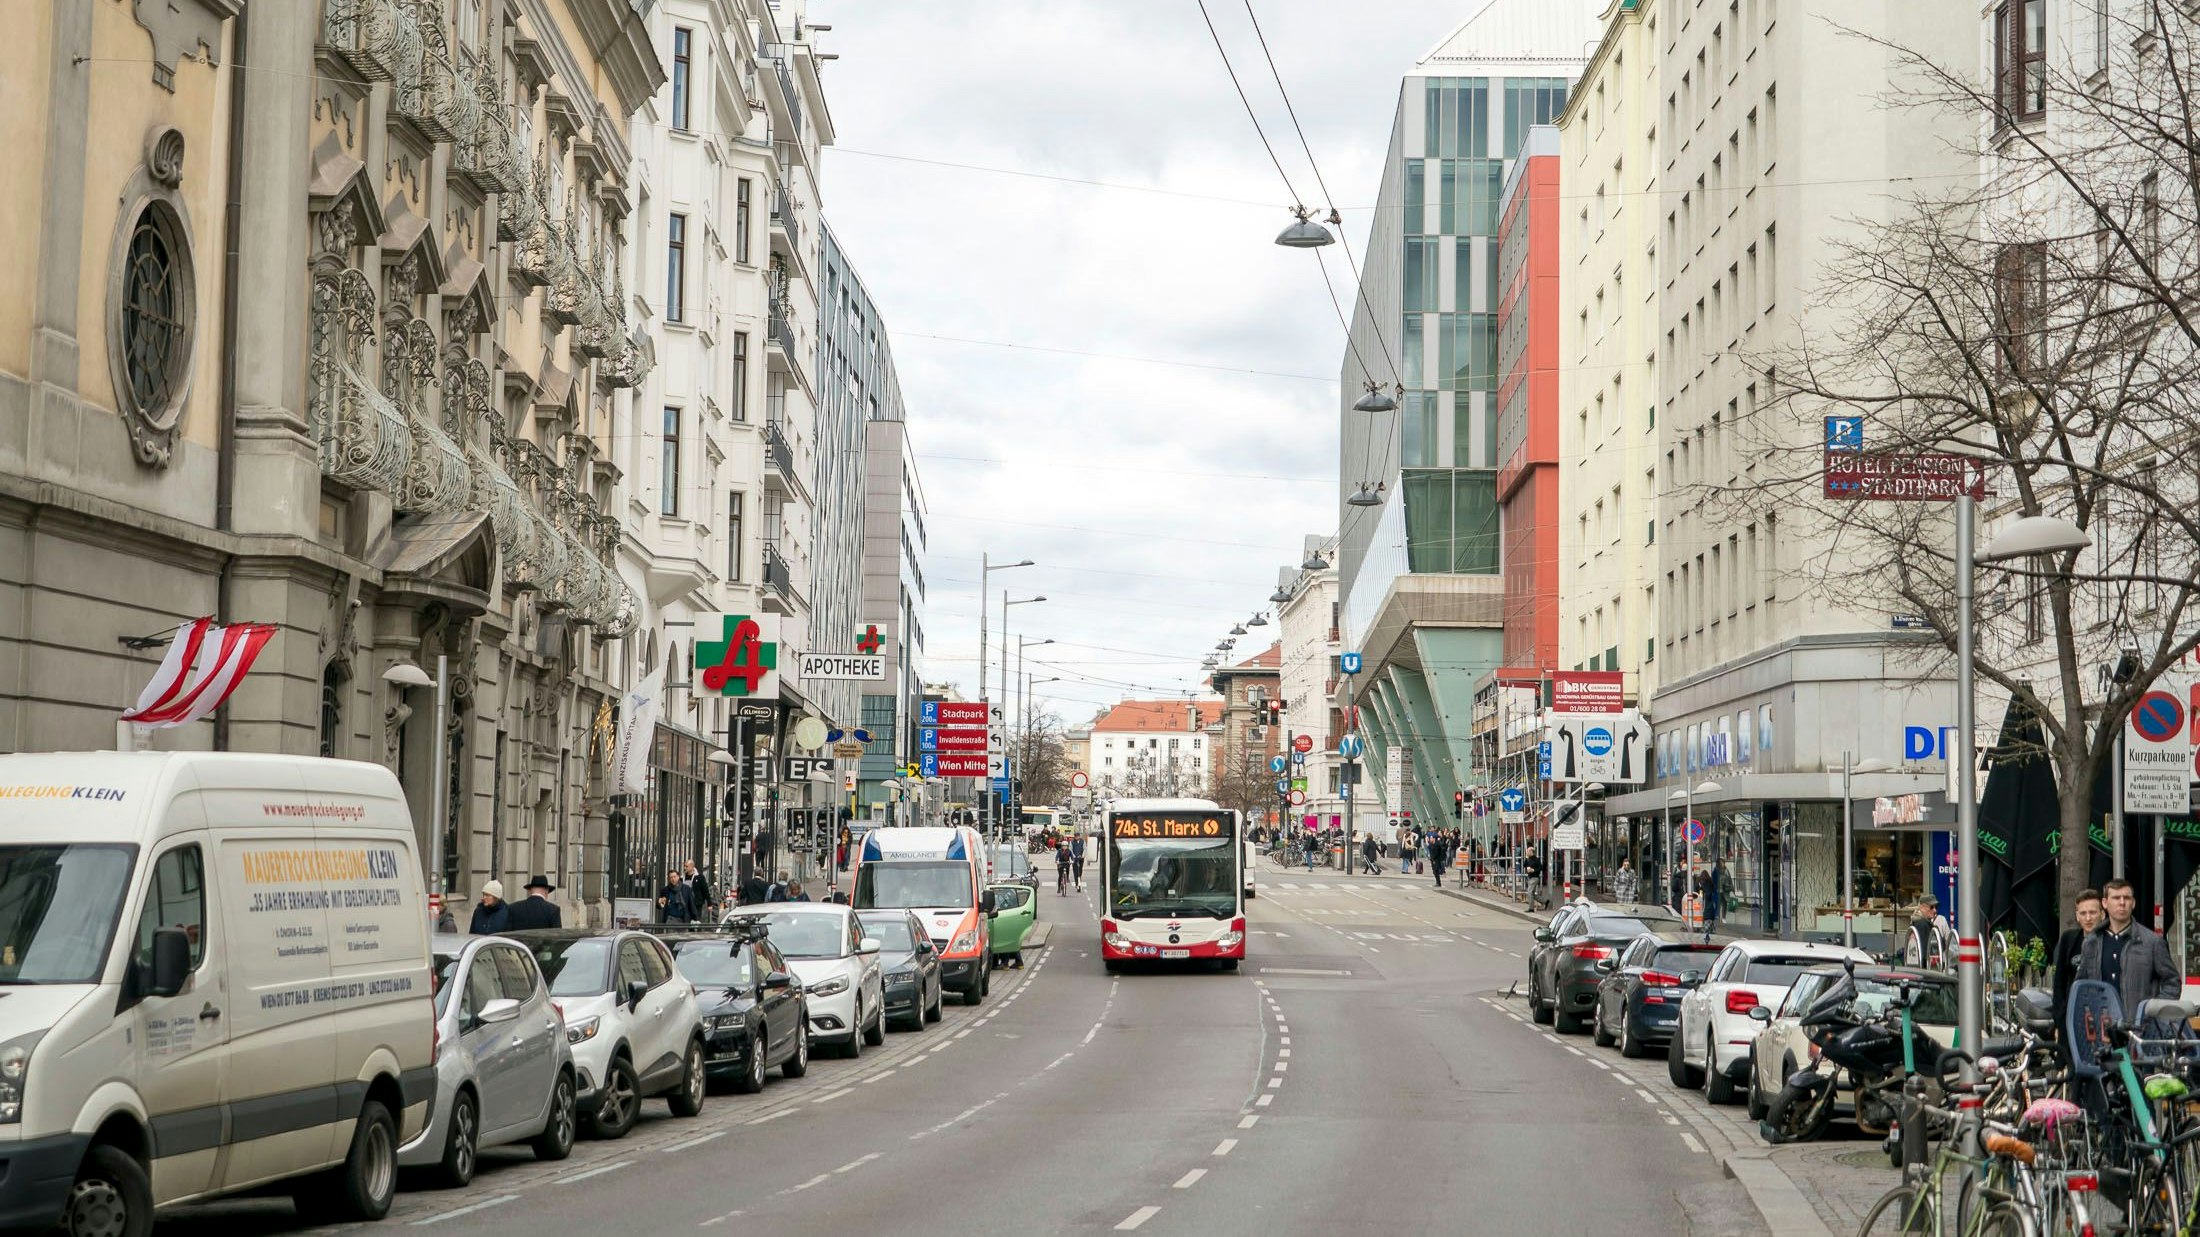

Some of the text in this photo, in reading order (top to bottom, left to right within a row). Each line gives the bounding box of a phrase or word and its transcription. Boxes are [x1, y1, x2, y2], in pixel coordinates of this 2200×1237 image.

[1835, 421, 1852, 442] P
[1829, 455, 1962, 474] HOTEL PENSION
[1861, 477, 1962, 496] STADTPARK
[804, 657, 880, 676] APOTHEKE
[1344, 656, 1358, 671] U
[942, 709, 984, 719] Stadtpark
[939, 735, 986, 744] Invalidenstraße
[618, 715, 637, 791] FRANZISKUS SPITAL
[2129, 748, 2186, 765] Kurzparkzone
[939, 761, 962, 770] Wien
[963, 760, 987, 770] Mitte
[1115, 819, 1200, 836] 74A St. Marx
[265, 891, 288, 911] JAHRE
[288, 889, 329, 910] ERFAHRUNG
[331, 889, 343, 908] MIT
[344, 888, 402, 908] EDELSTAHLPLATTEN
